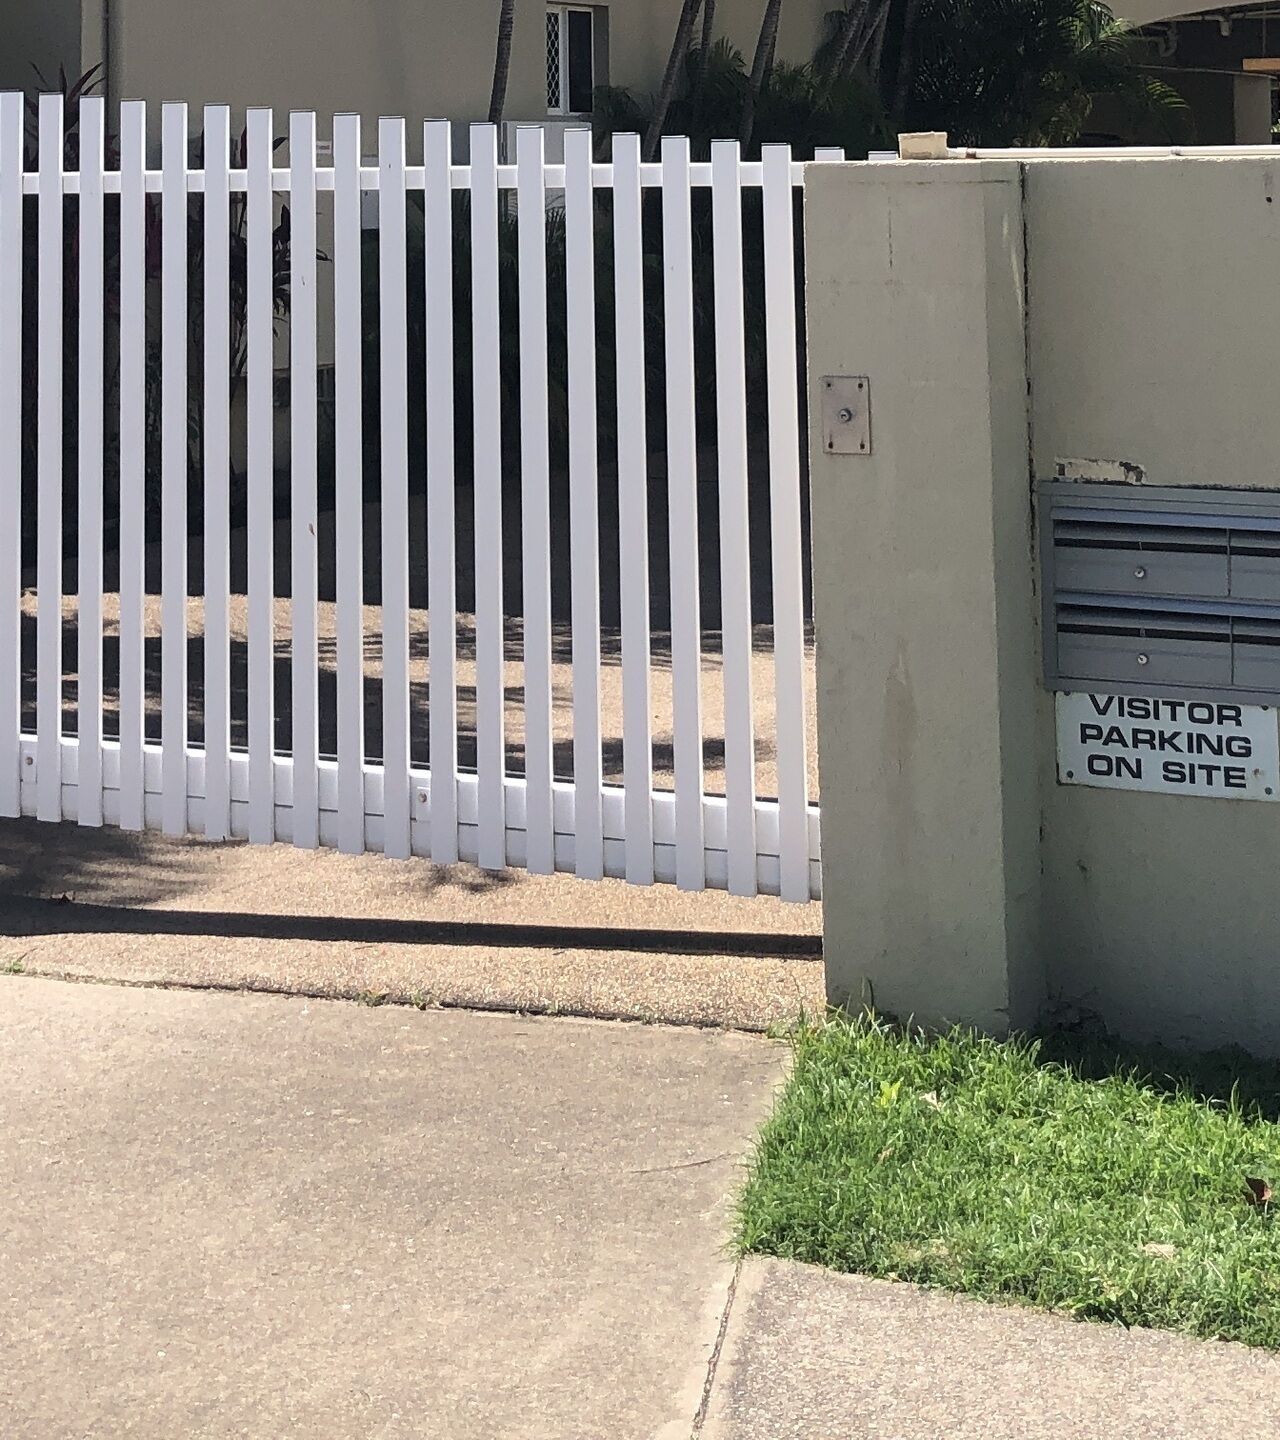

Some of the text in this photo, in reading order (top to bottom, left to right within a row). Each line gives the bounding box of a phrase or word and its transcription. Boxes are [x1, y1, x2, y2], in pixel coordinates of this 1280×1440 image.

[1087, 693, 1243, 727] VISITOR
[1079, 722, 1252, 758] PARKING
[1087, 754, 1247, 789] ON SITE
